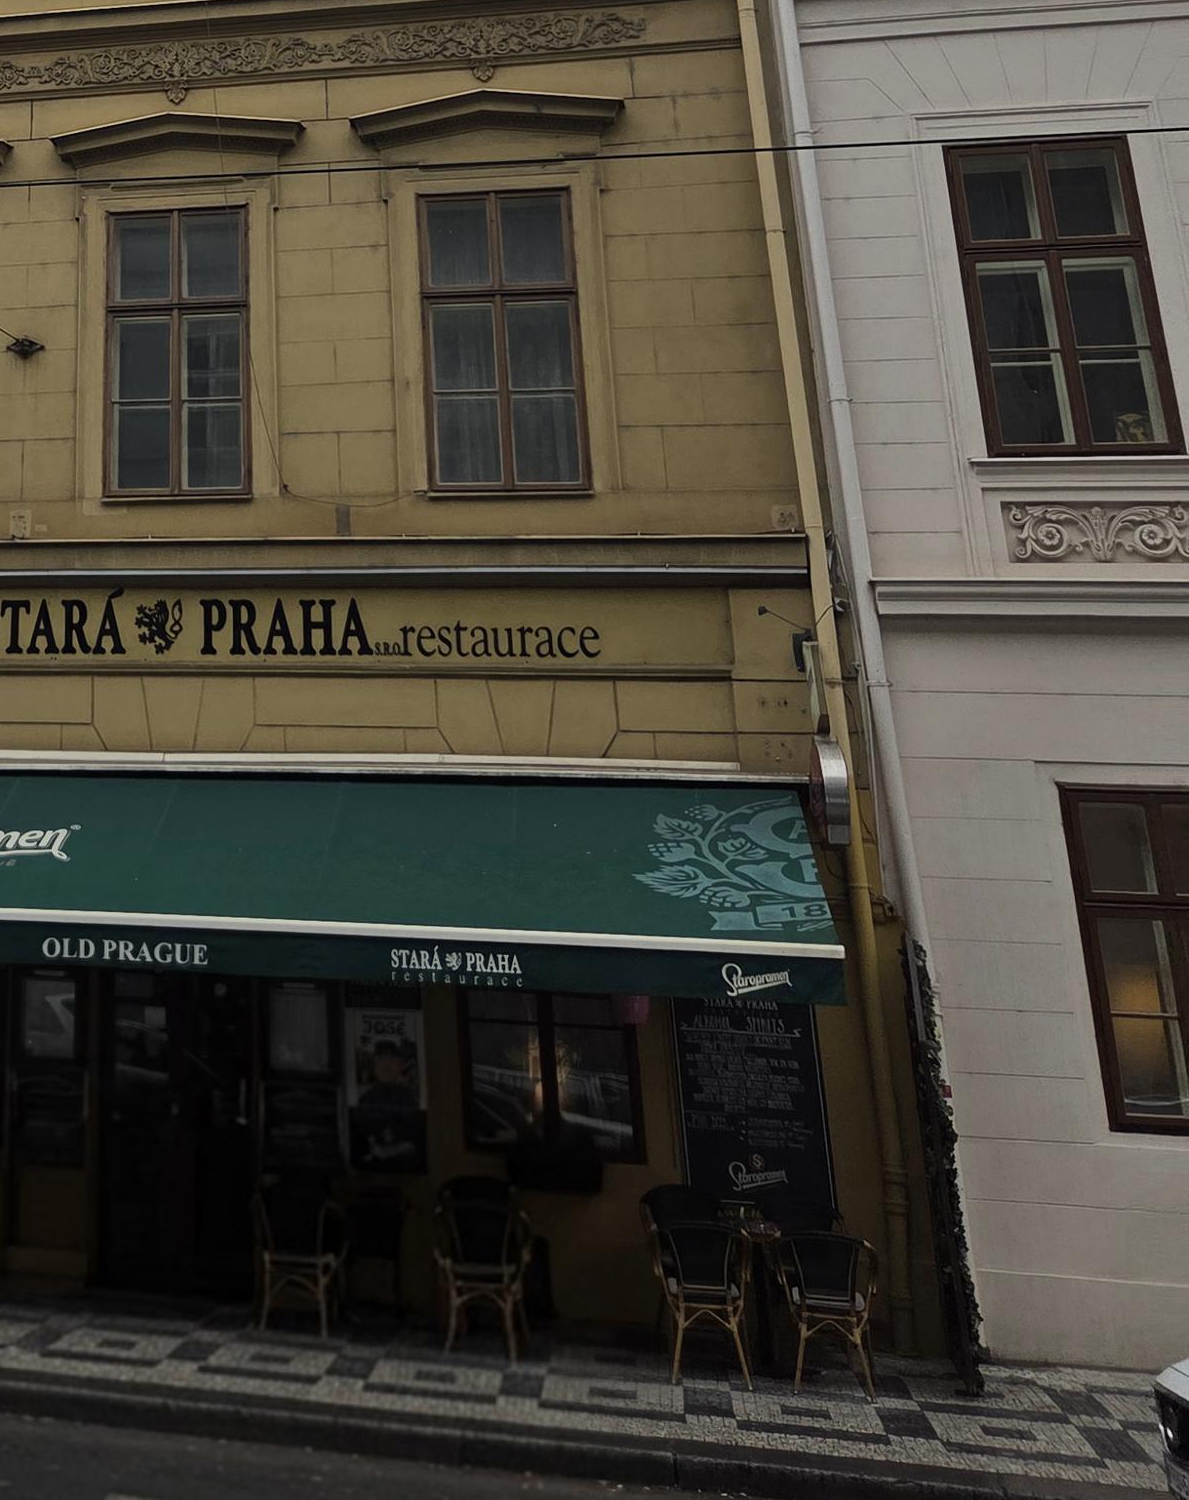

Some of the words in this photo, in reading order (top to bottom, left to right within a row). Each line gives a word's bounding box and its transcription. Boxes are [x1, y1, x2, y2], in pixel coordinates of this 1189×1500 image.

[199, 597, 374, 656] PRAHA
[399, 619, 602, 658] restaurace
[42, 936, 96, 959] OLD
[102, 938, 209, 965] PRAGUE
[390, 945, 443, 971] STARÁ
[465, 952, 523, 975] PRAHA
[391, 970, 524, 988] restaurace
[721, 962, 793, 997] Staropramen
